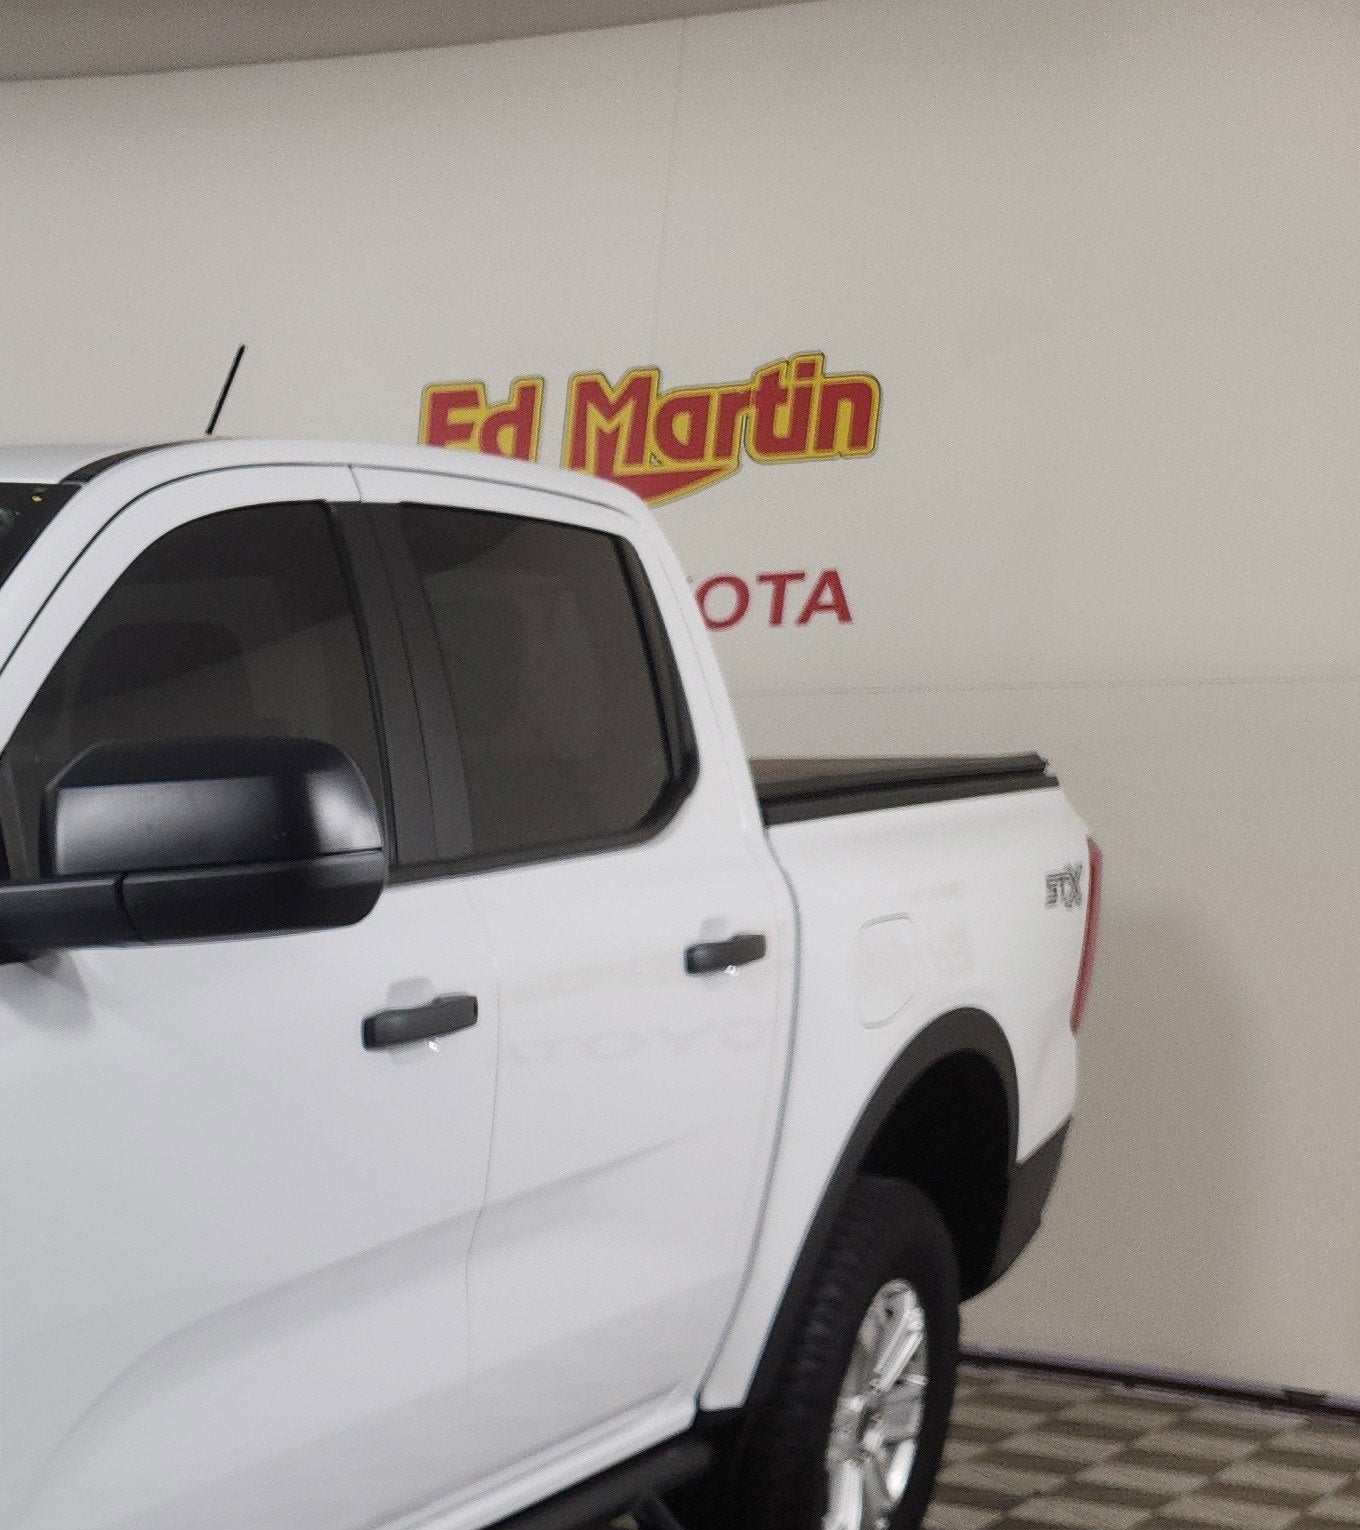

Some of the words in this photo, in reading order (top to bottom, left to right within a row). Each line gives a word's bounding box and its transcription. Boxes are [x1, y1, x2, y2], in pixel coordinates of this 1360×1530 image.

[420, 376, 544, 462] Ed
[563, 351, 881, 474] Martin
[695, 568, 853, 631] OTA
